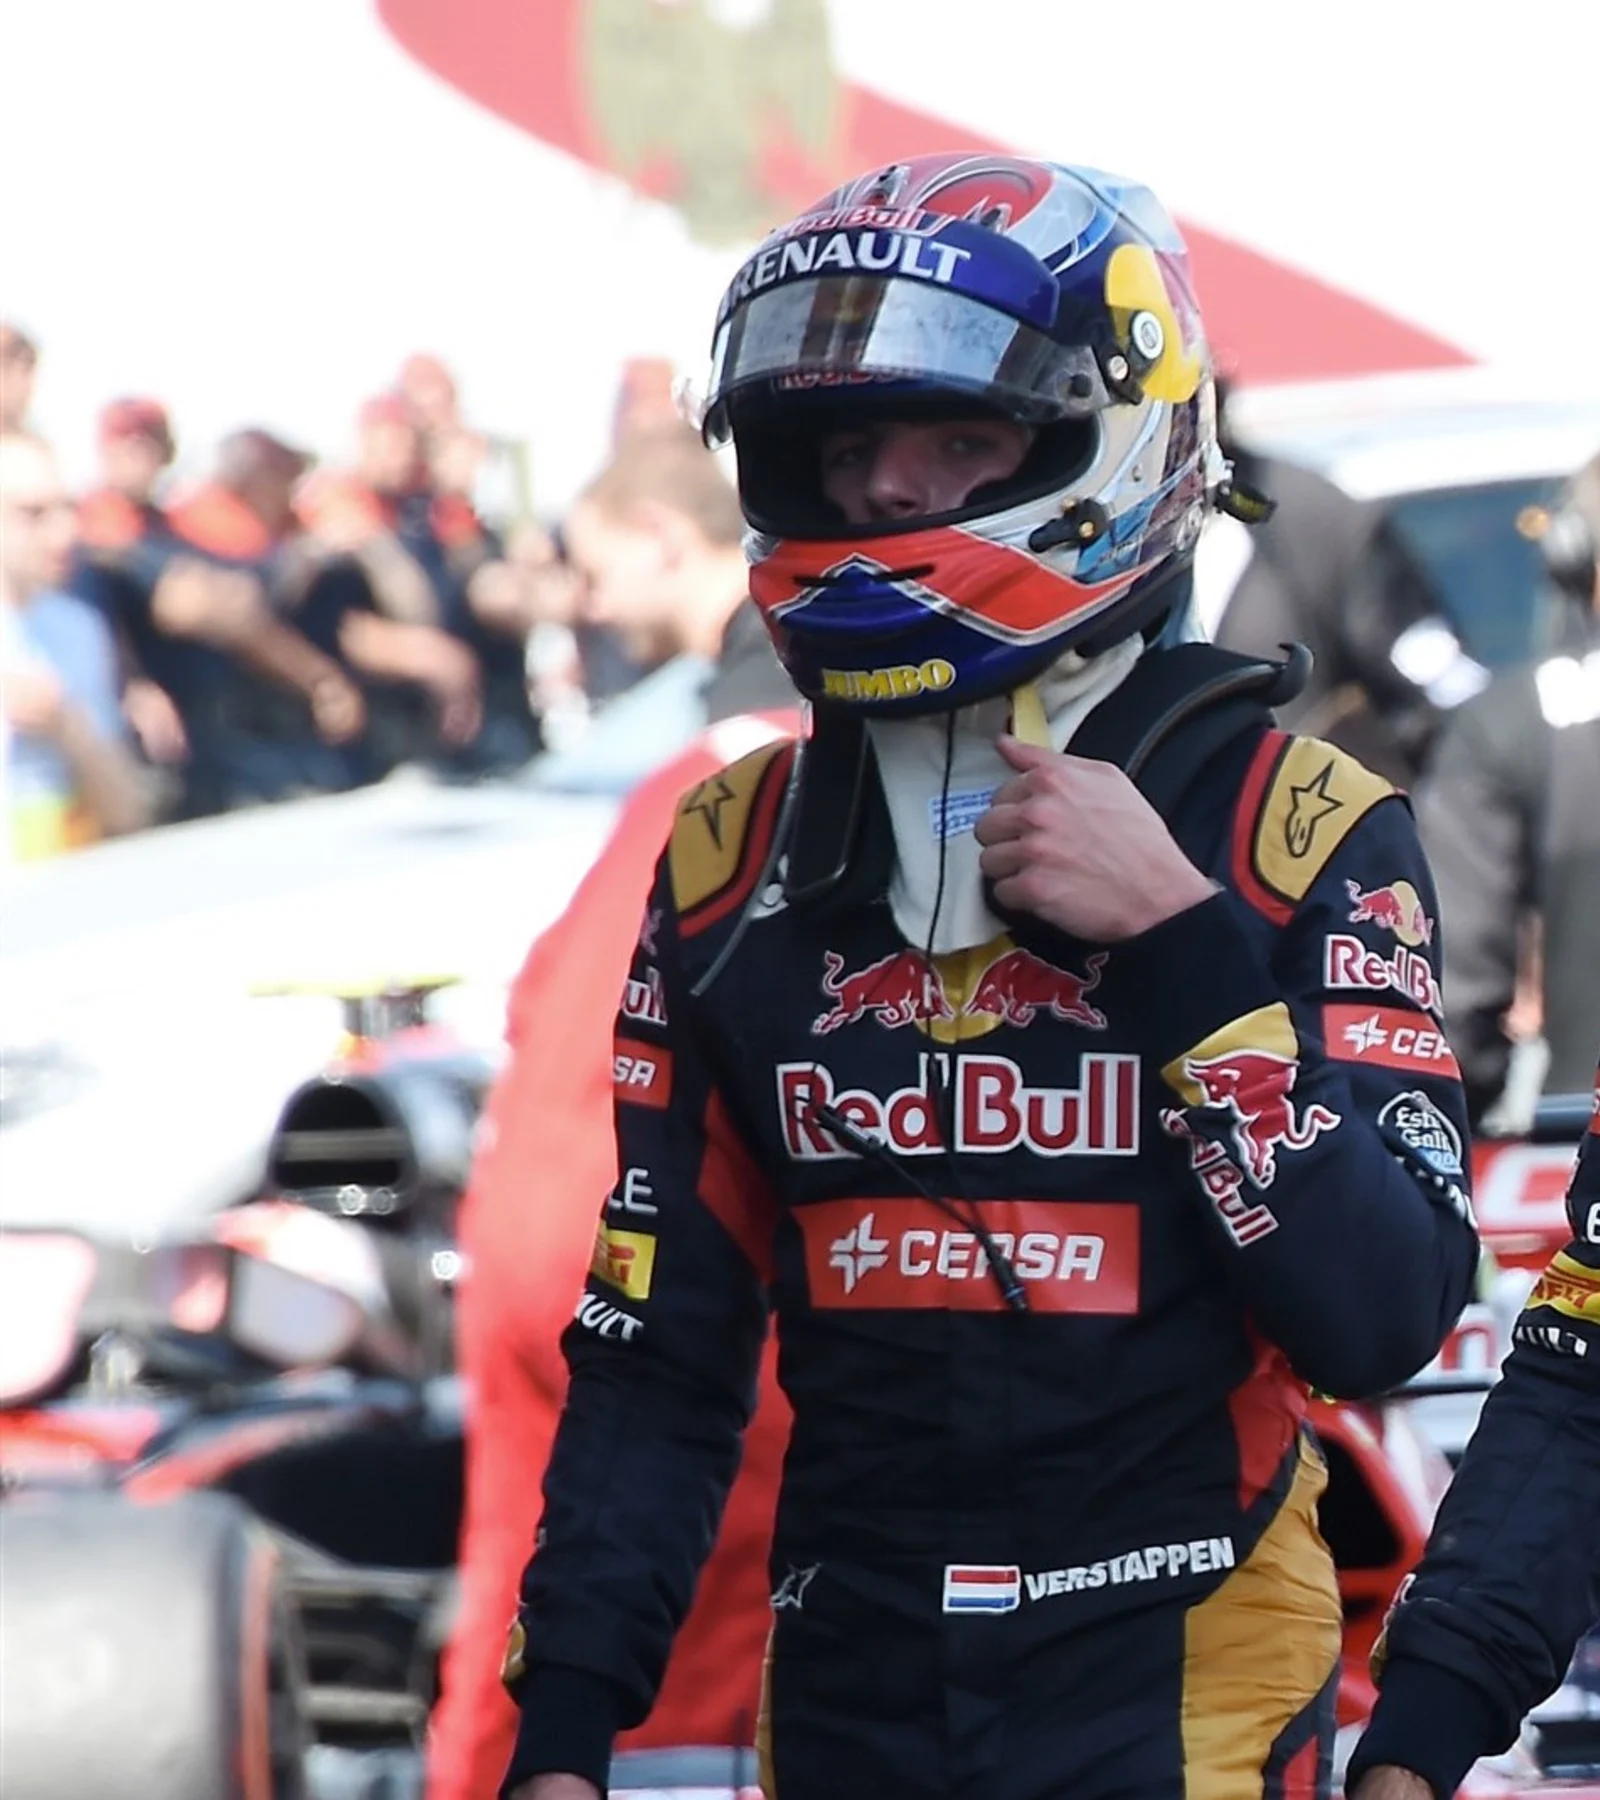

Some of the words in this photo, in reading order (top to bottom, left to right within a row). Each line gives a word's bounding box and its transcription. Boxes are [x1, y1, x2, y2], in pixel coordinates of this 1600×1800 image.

[841, 205, 926, 231] Bull
[729, 232, 972, 300] RENAULT
[1323, 933, 1408, 996] Red
[776, 1052, 950, 1160] Red
[954, 1053, 1141, 1157] Bull
[1198, 1157, 1281, 1248] Bull
[899, 1229, 1105, 1282] CEPSA
[1024, 1536, 1236, 1602] VERSTAPPEN
